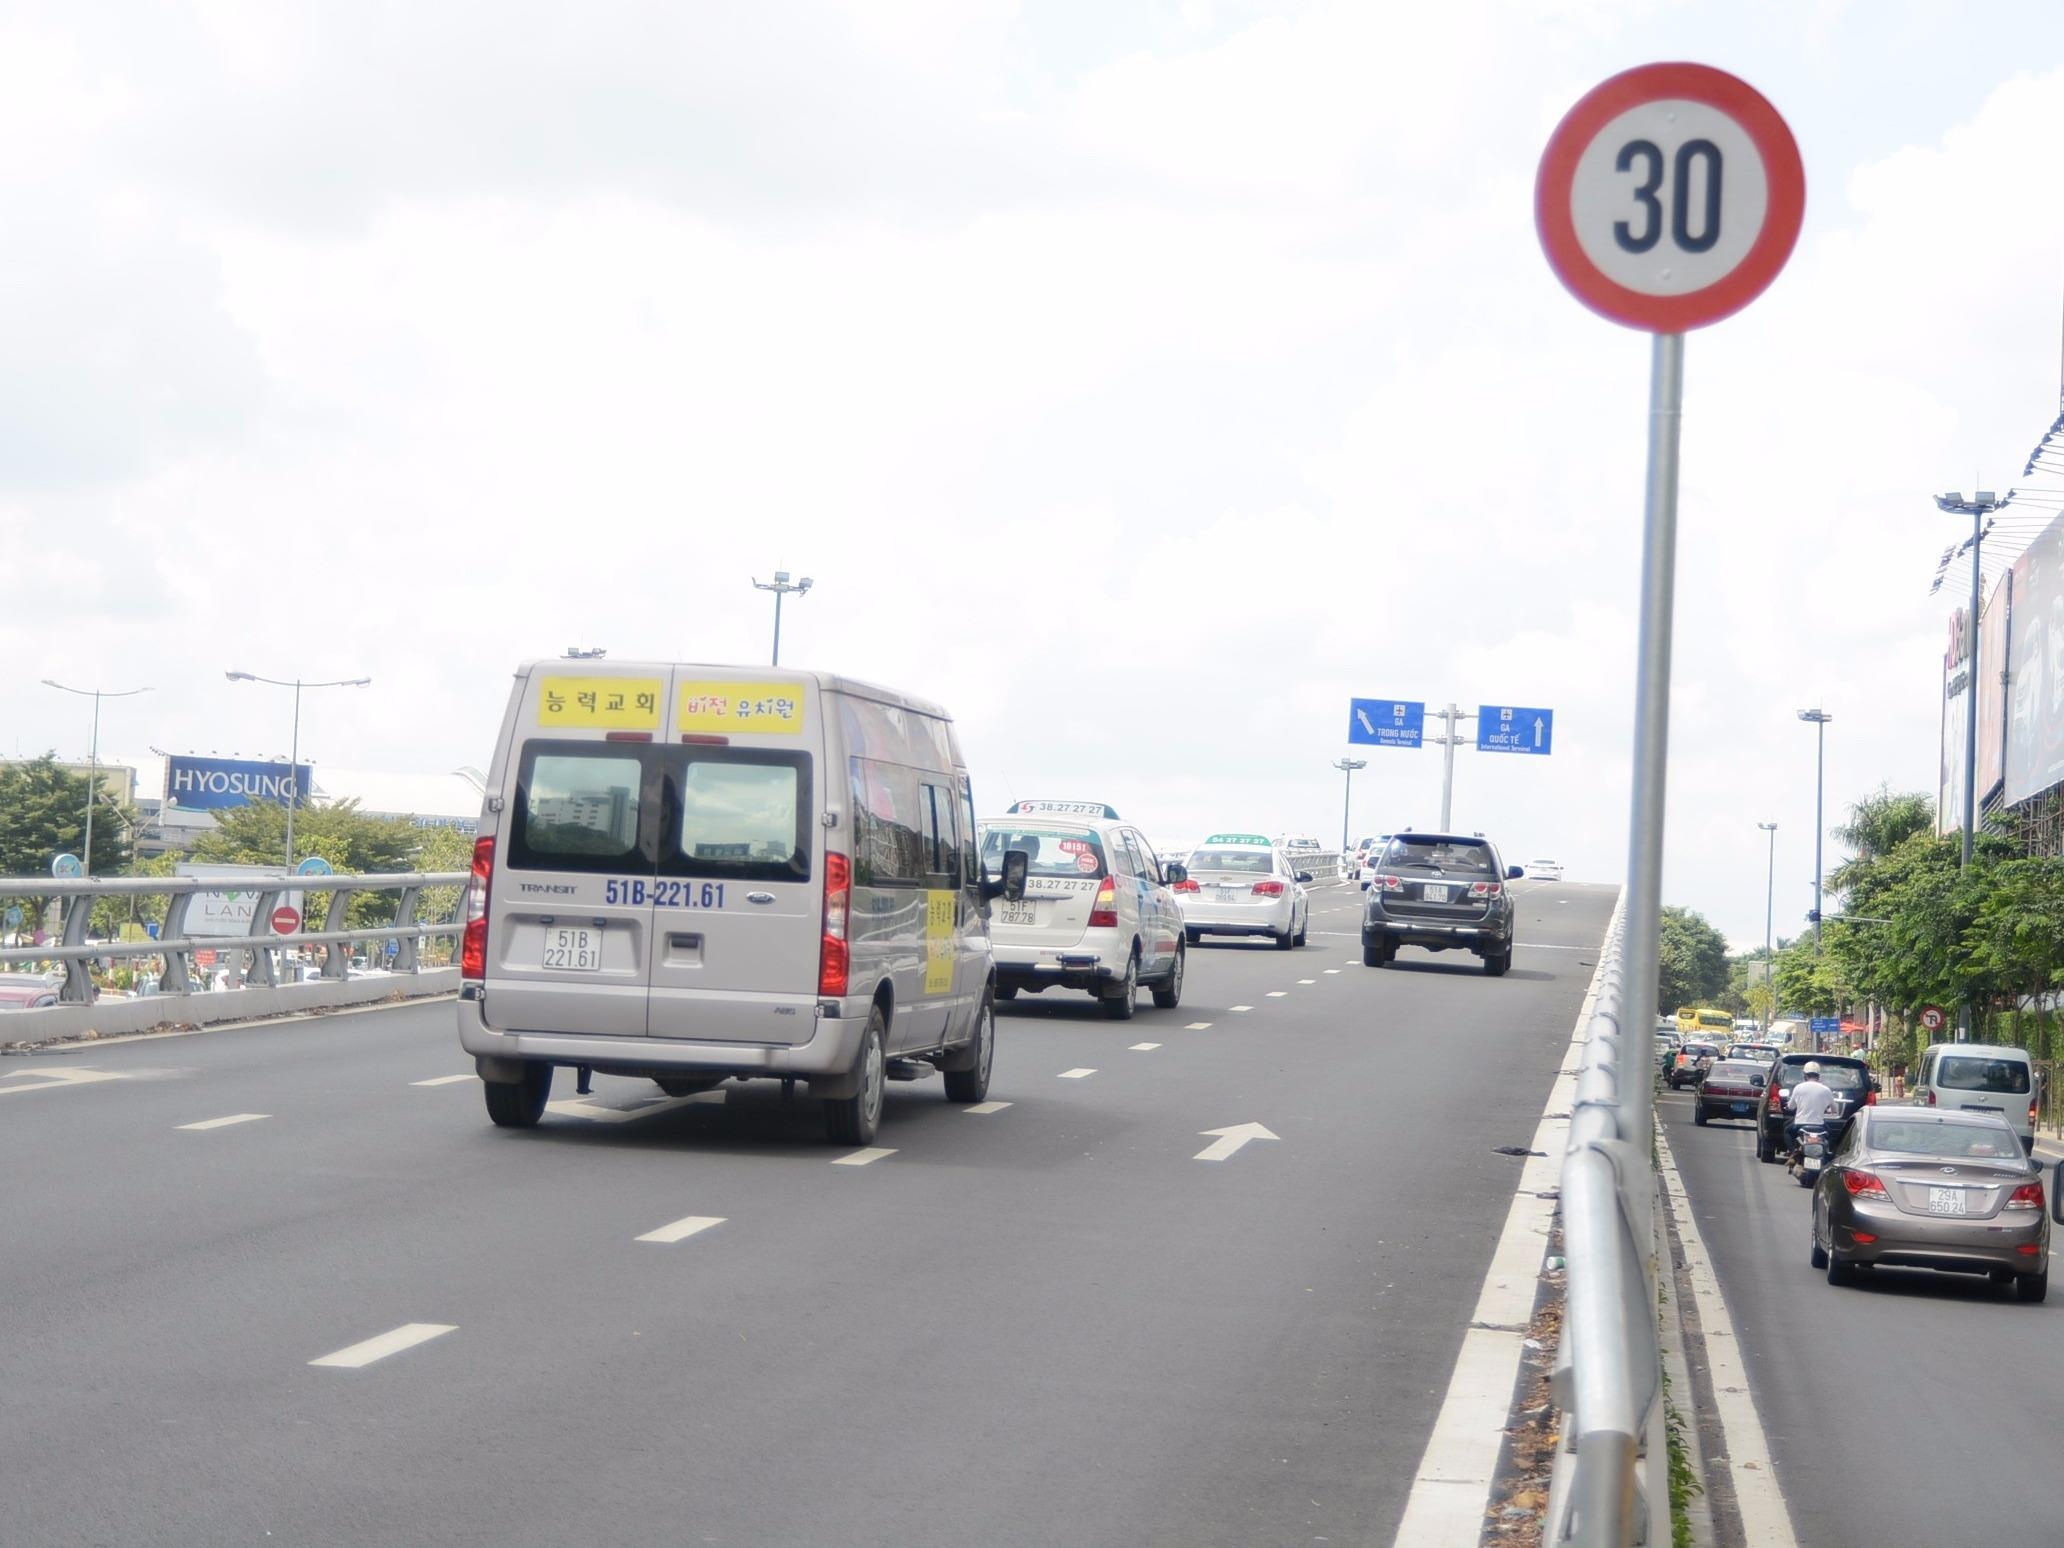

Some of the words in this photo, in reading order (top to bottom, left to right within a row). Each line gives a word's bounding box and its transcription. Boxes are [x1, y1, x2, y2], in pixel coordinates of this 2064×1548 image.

[1613, 138, 1723, 255] 30
[546, 690, 656, 715] 능력교회
[687, 697, 728, 716] 비전
[736, 698, 795, 719] 유치원
[1394, 717, 1404, 727] GA
[1500, 723, 1510, 733] GA
[1377, 727, 1399, 738] TRONG
[174, 769, 298, 798] HYOSUNG
[1072, 804, 1086, 813] 27
[1088, 805, 1102, 814] 27
[1063, 880, 1078, 890] 27
[1080, 882, 1095, 891] 27
[519, 883, 578, 895] TRANSIT
[605, 879, 725, 908] 51B-221.61
[204, 904, 252, 917] LAN
[558, 930, 589, 949] 51B
[545, 949, 596, 968] 221.61
[1938, 1190, 1958, 1201] 29A
